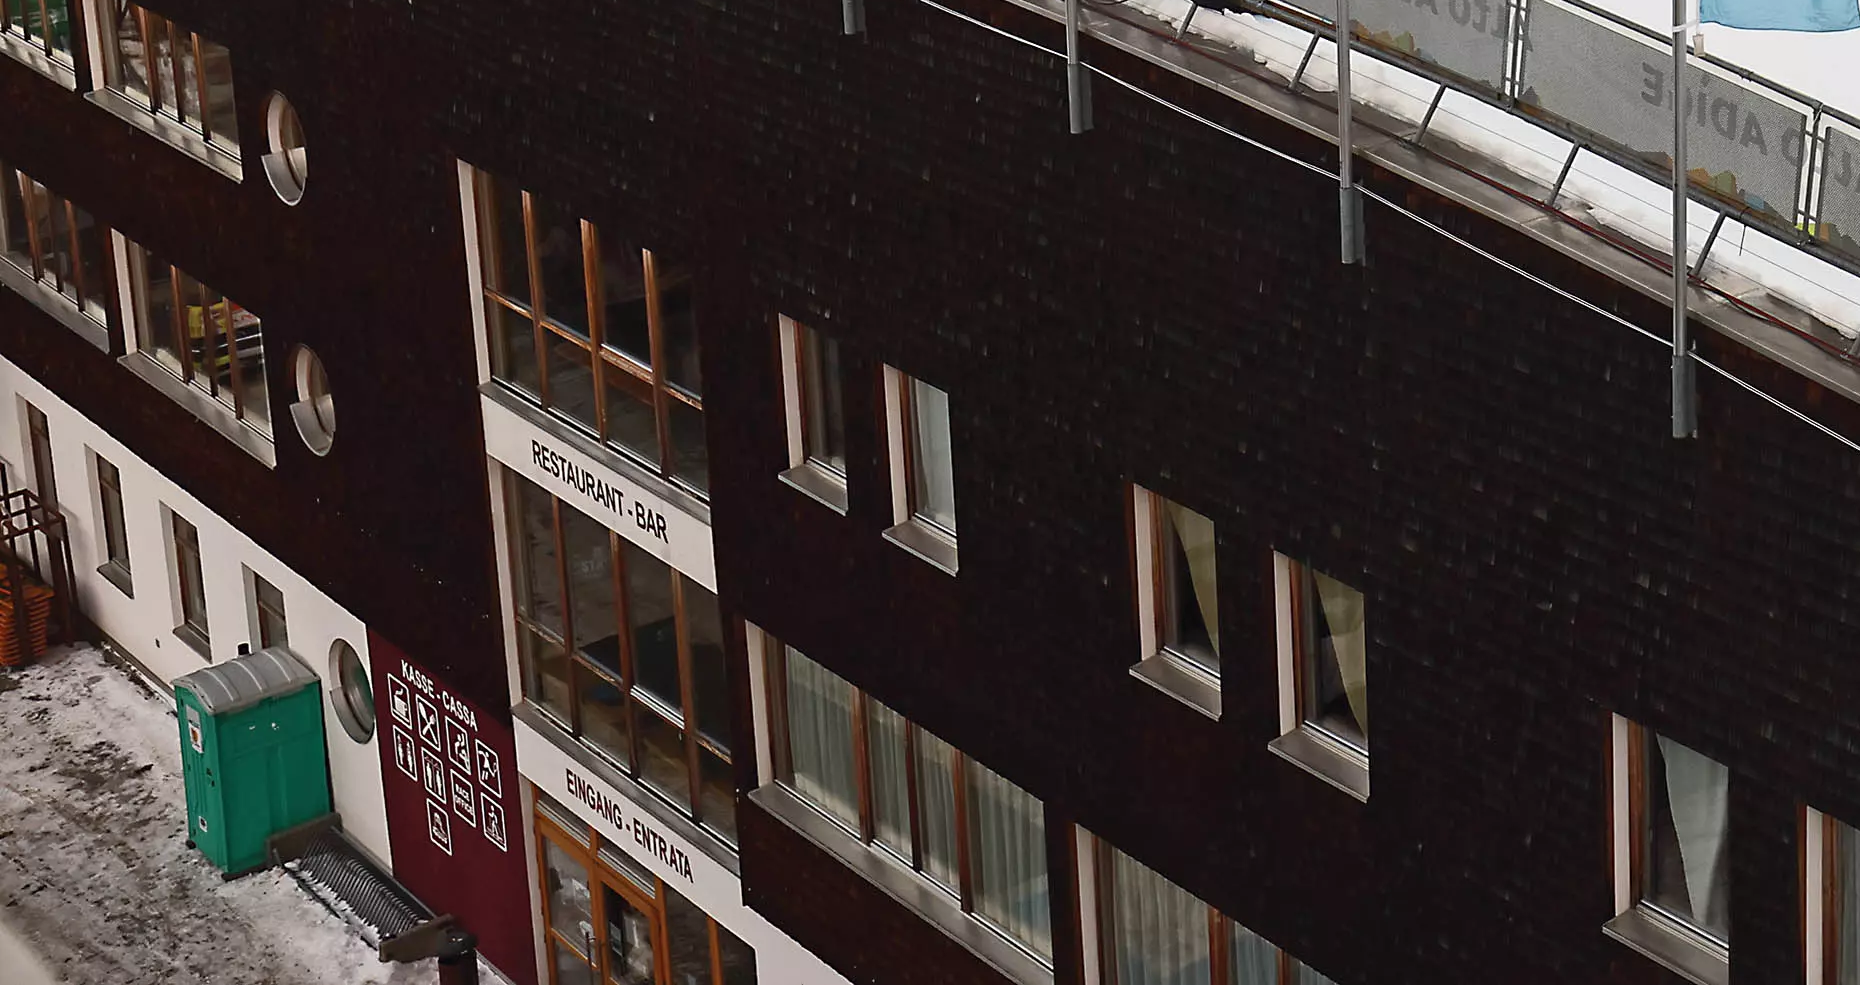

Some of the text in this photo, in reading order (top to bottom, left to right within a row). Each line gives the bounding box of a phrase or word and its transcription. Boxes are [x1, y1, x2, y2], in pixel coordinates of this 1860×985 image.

[531, 439, 624, 516] RESTAURANT
[634, 500, 669, 544] BAR
[401, 659, 435, 699] KASSE
[442, 690, 479, 732] CASSA
[455, 783, 470, 802] RACE
[566, 768, 623, 830] EINGANG
[633, 817, 694, 884] ENTRATA
